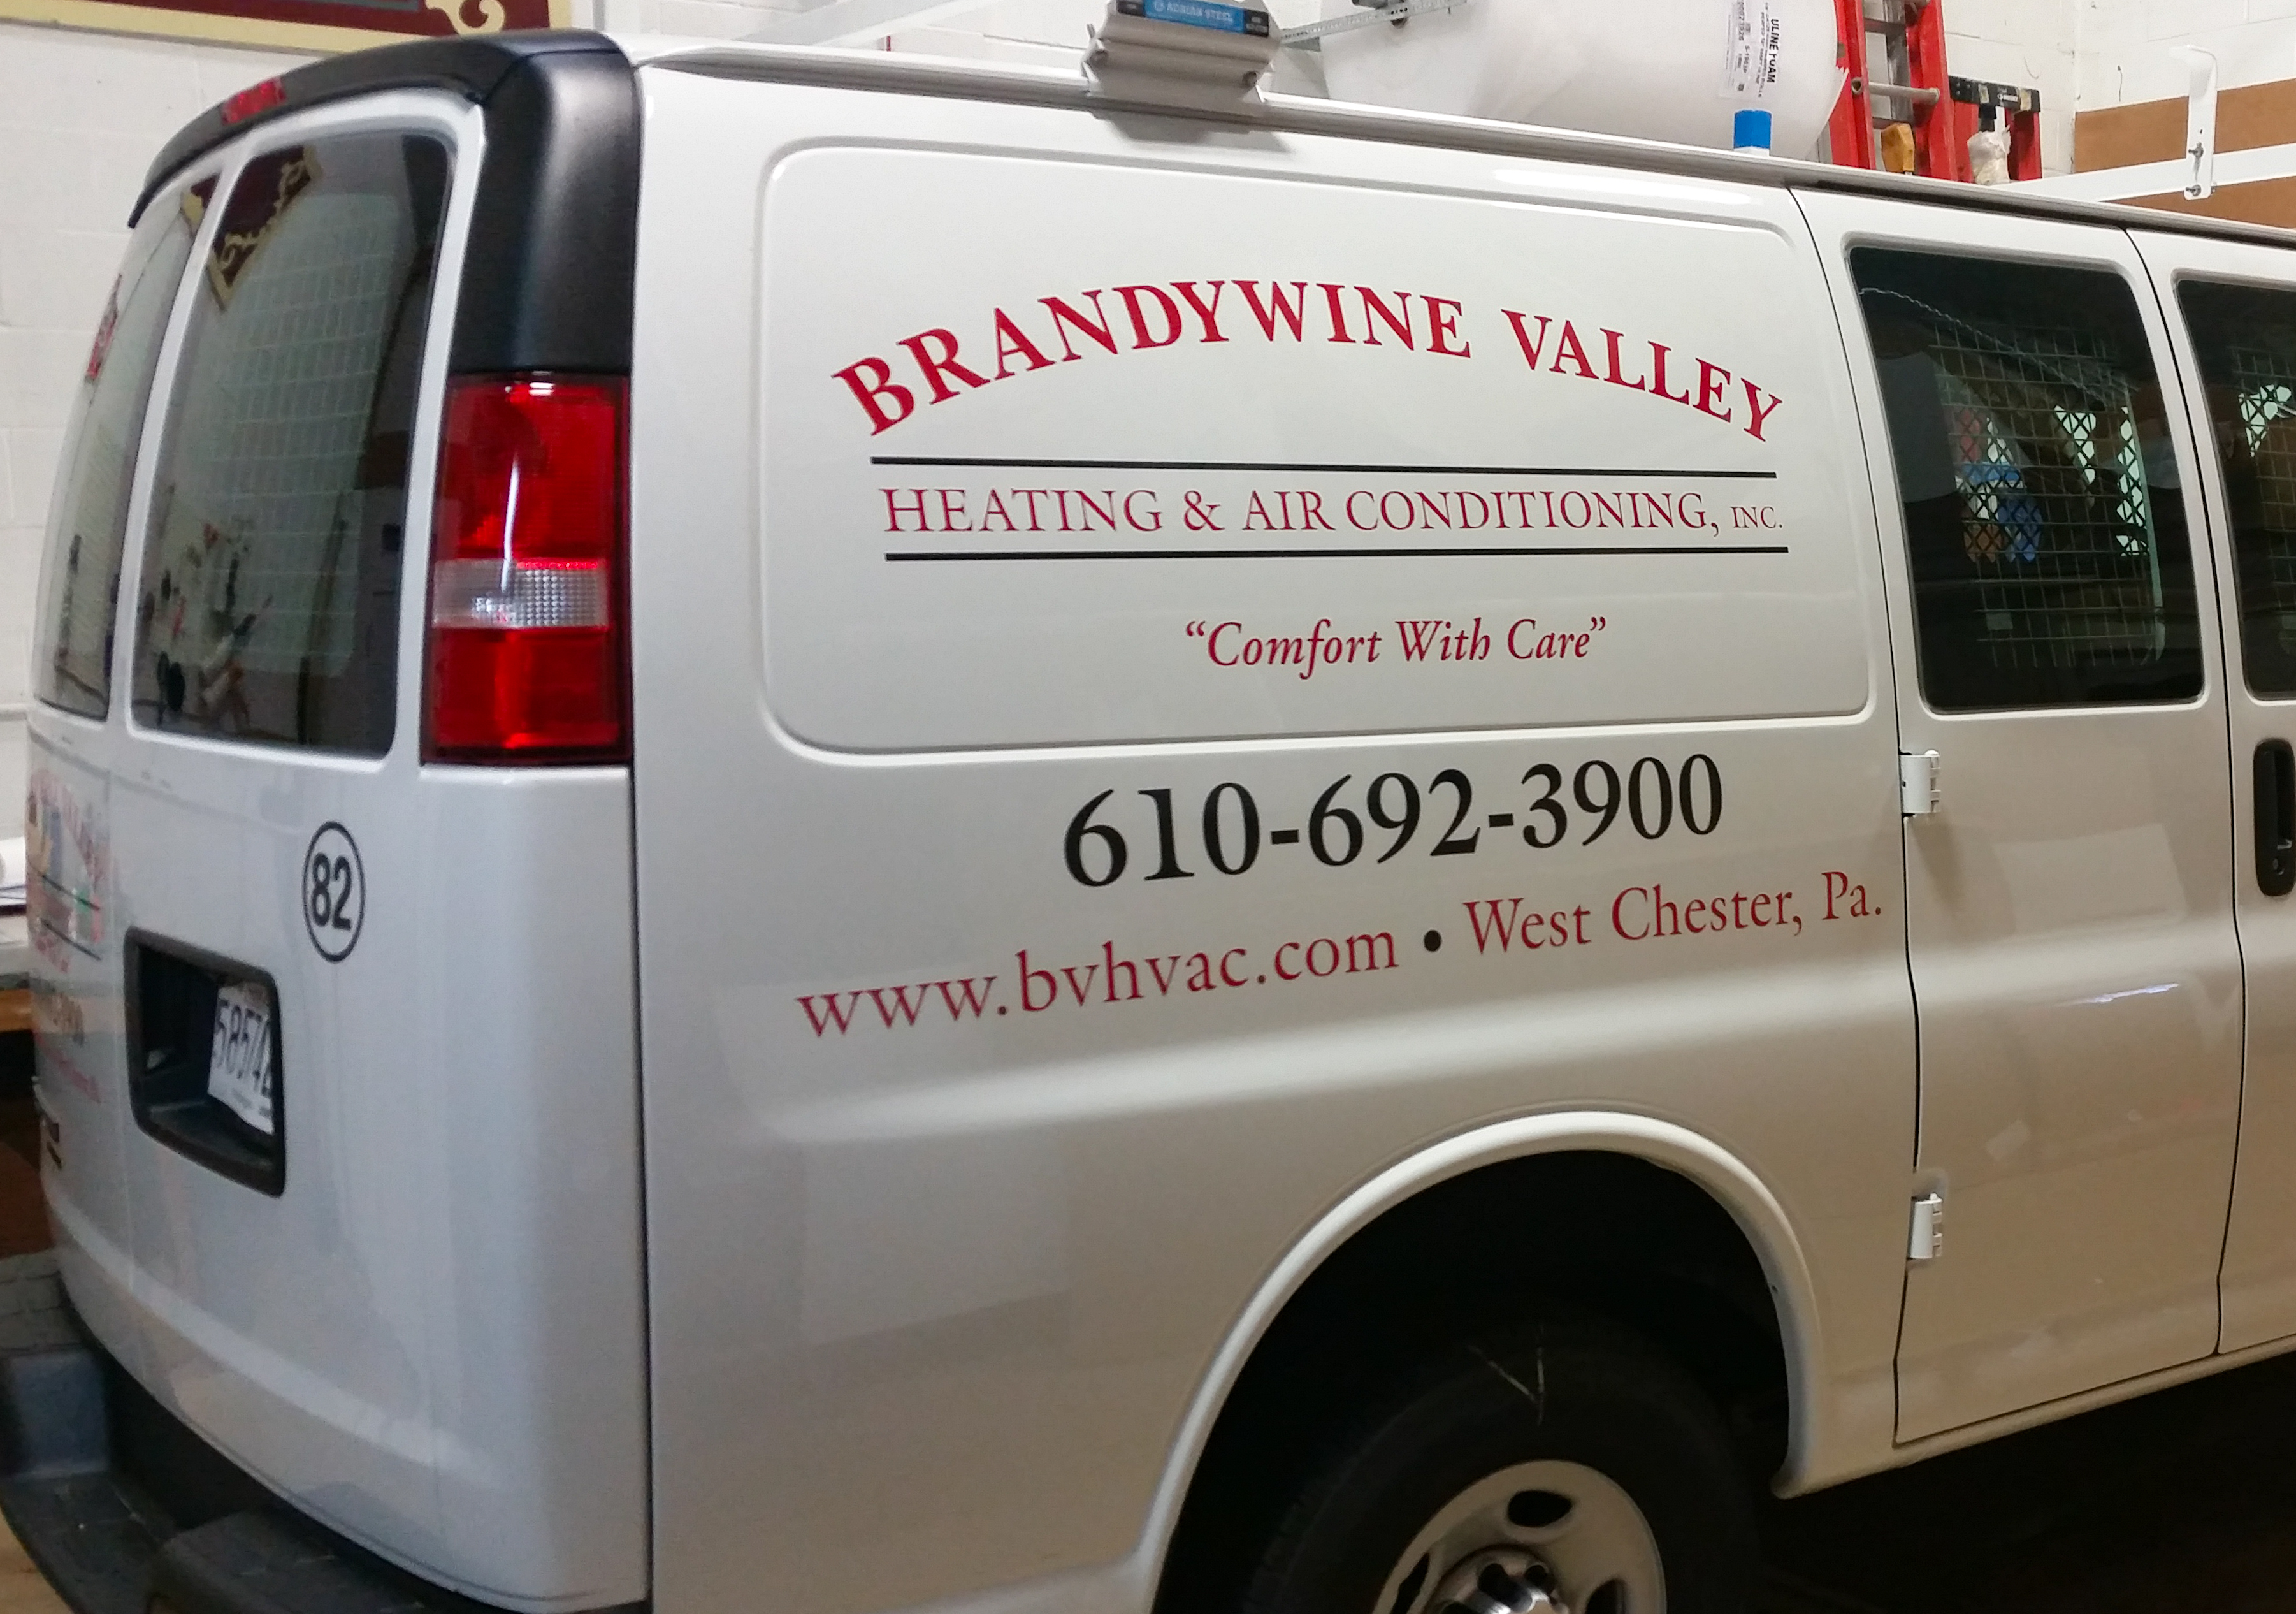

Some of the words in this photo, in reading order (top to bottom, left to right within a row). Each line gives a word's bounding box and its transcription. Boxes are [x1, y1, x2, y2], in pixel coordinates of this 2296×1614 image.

[1770, 18, 1779, 50] ULINE
[831, 280, 1471, 437] BRANDYWINE
[1501, 309, 1782, 442] VALLEY
[879, 488, 1162, 532] HEATING
[1183, 490, 1225, 531] &
[1242, 490, 1336, 530] AIR
[1346, 491, 1719, 537] CONDITIONING,
[1730, 506, 1783, 529] INC.
[1395, 617, 1490, 662] With
[1064, 753, 1723, 887] 610-692-3900
[312, 852, 353, 931] 82
[796, 930, 1399, 1038] www.bvhvac.com
[1462, 897, 1592, 955] West
[1612, 883, 1802, 941] Chester,
[1821, 871, 1882, 920] Pa.
